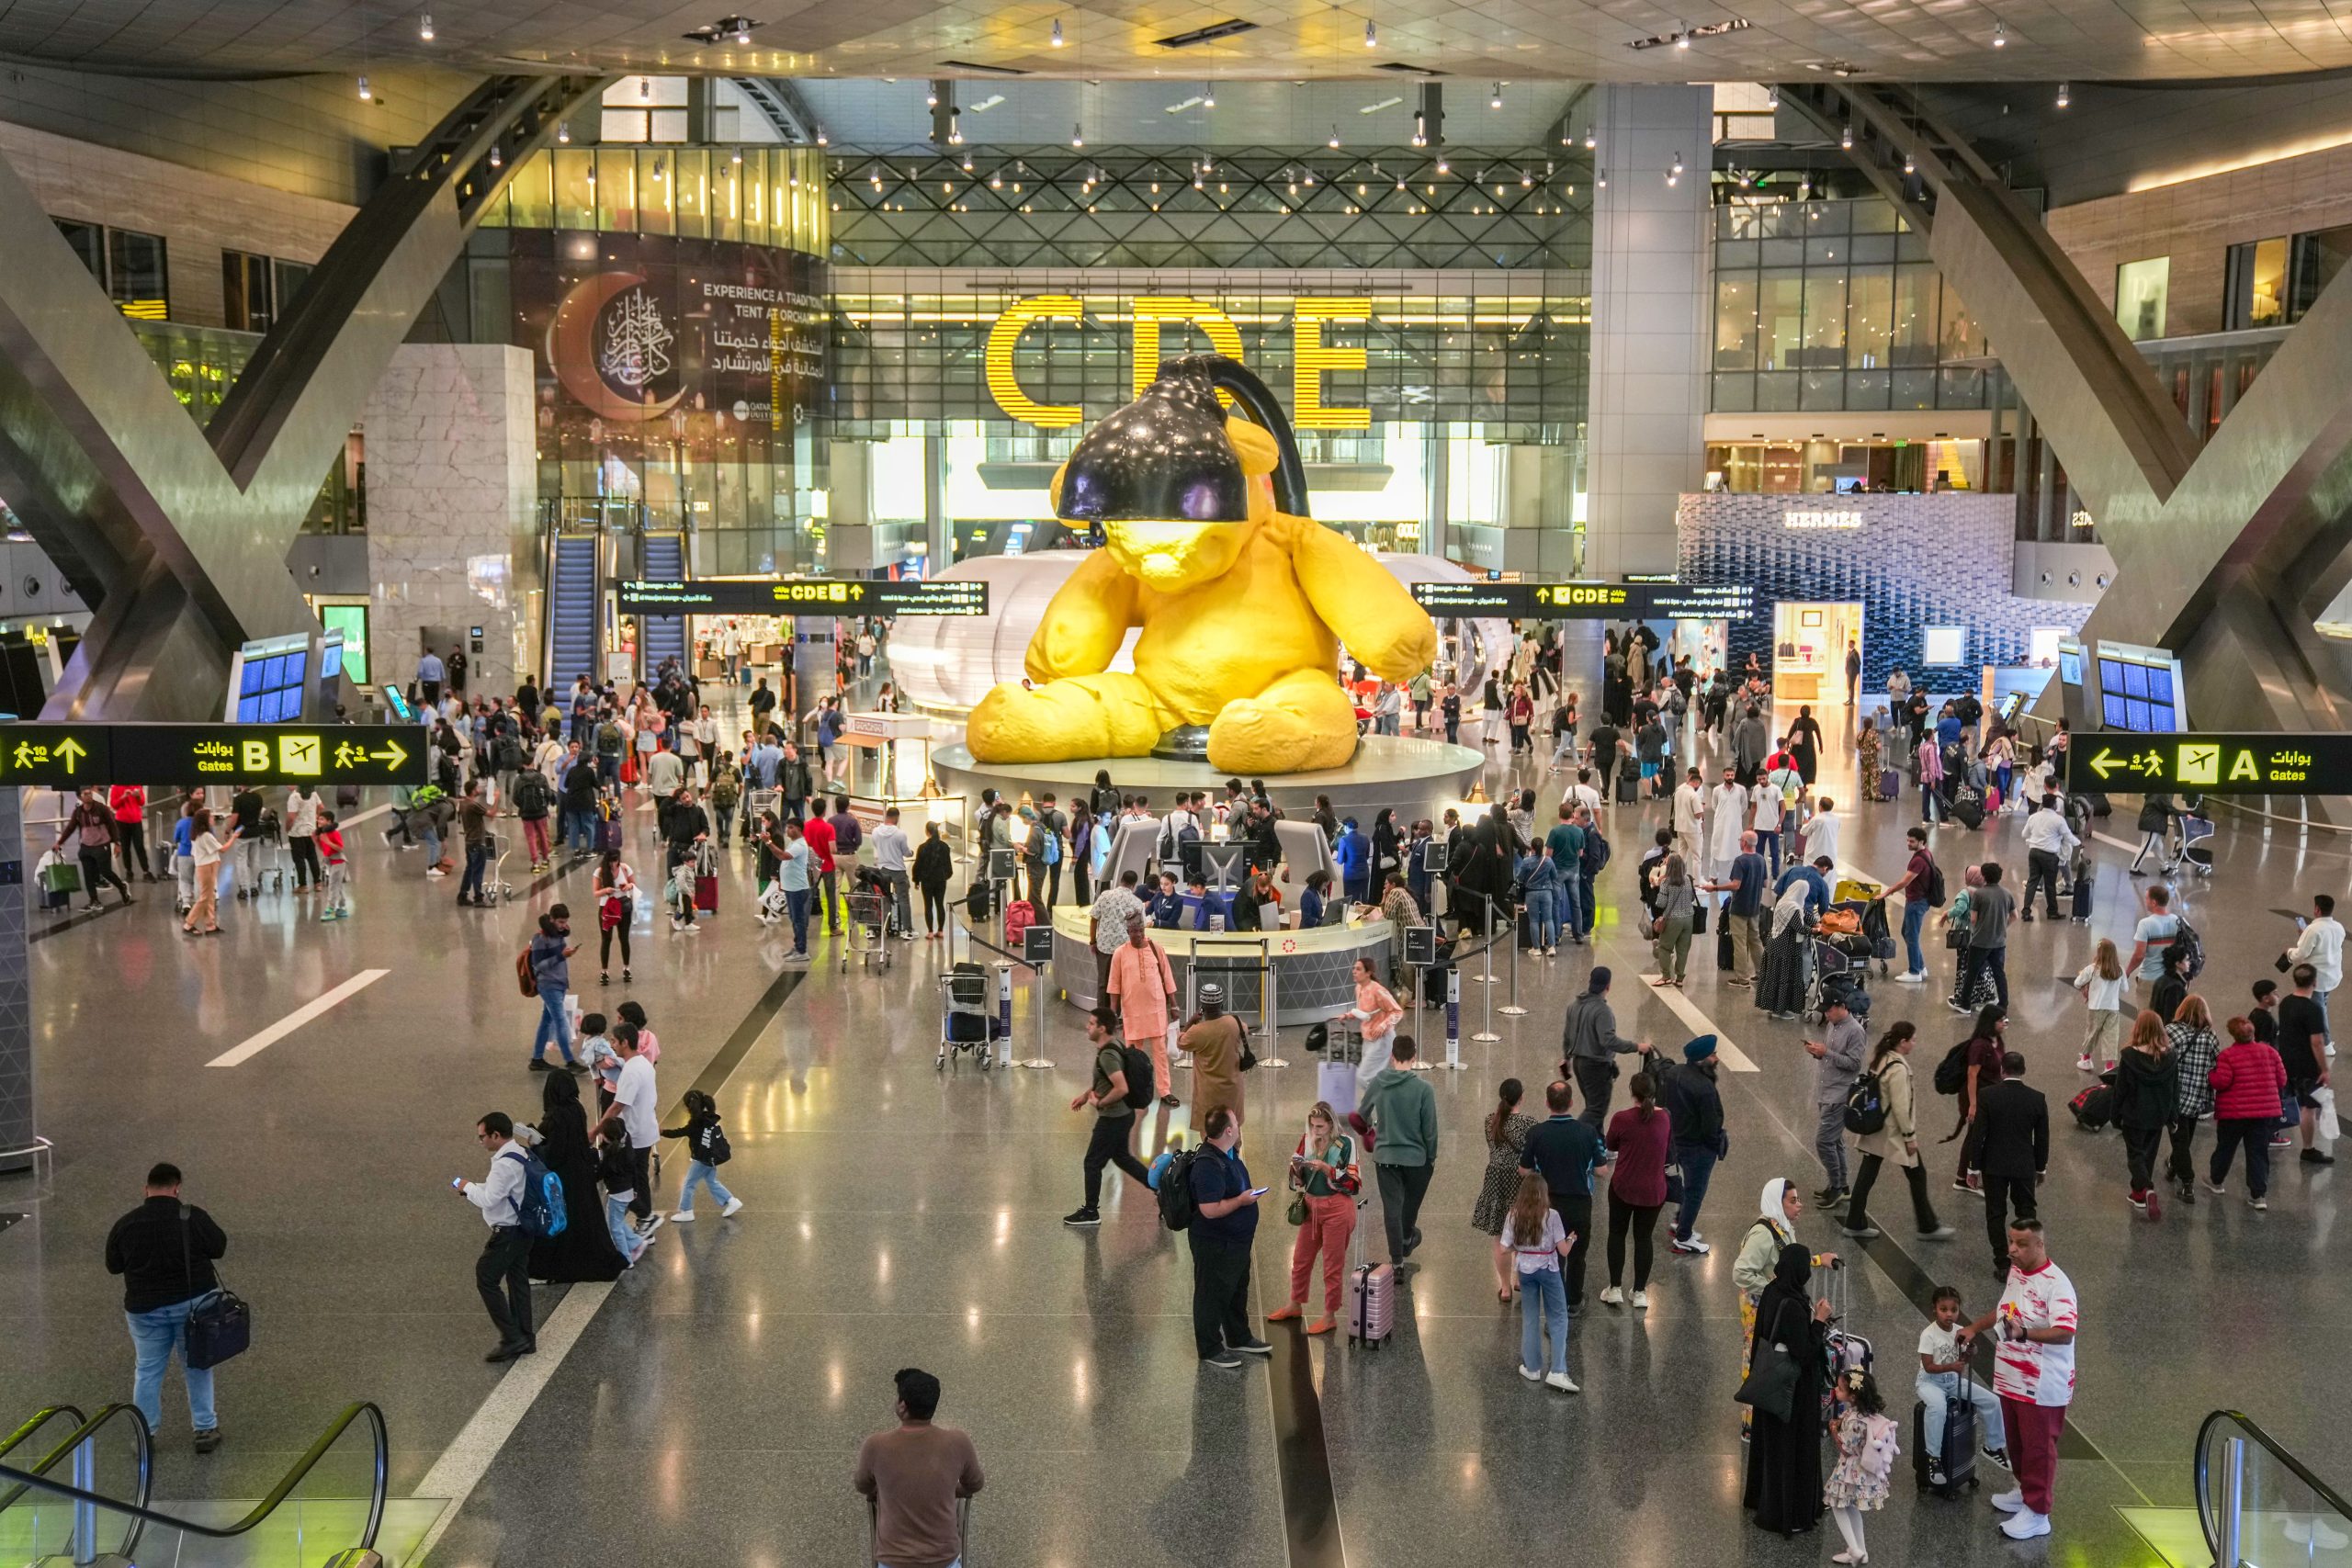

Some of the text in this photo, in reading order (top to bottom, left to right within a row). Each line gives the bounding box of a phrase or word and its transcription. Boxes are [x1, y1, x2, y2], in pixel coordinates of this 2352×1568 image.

[704, 283, 775, 301] EXPERIENCE
[776, 290, 785, 303] A
[735, 304, 763, 319] TENT
[714, 330, 759, 352] خيمتنا
[750, 402, 772, 412] QATAR
[790, 585, 829, 601] CDE
[1572, 588, 1609, 604] CDE
[32, 746, 48, 756] 10
[193, 741, 234, 757] بوابات
[242, 740, 270, 772] B
[356, 745, 365, 756] 3
[2132, 754, 2141, 764] 3
[2228, 750, 2259, 781] A
[2270, 750, 2312, 766] بوابات
[198, 761, 234, 772] Gates
[2269, 770, 2306, 781] Gates
